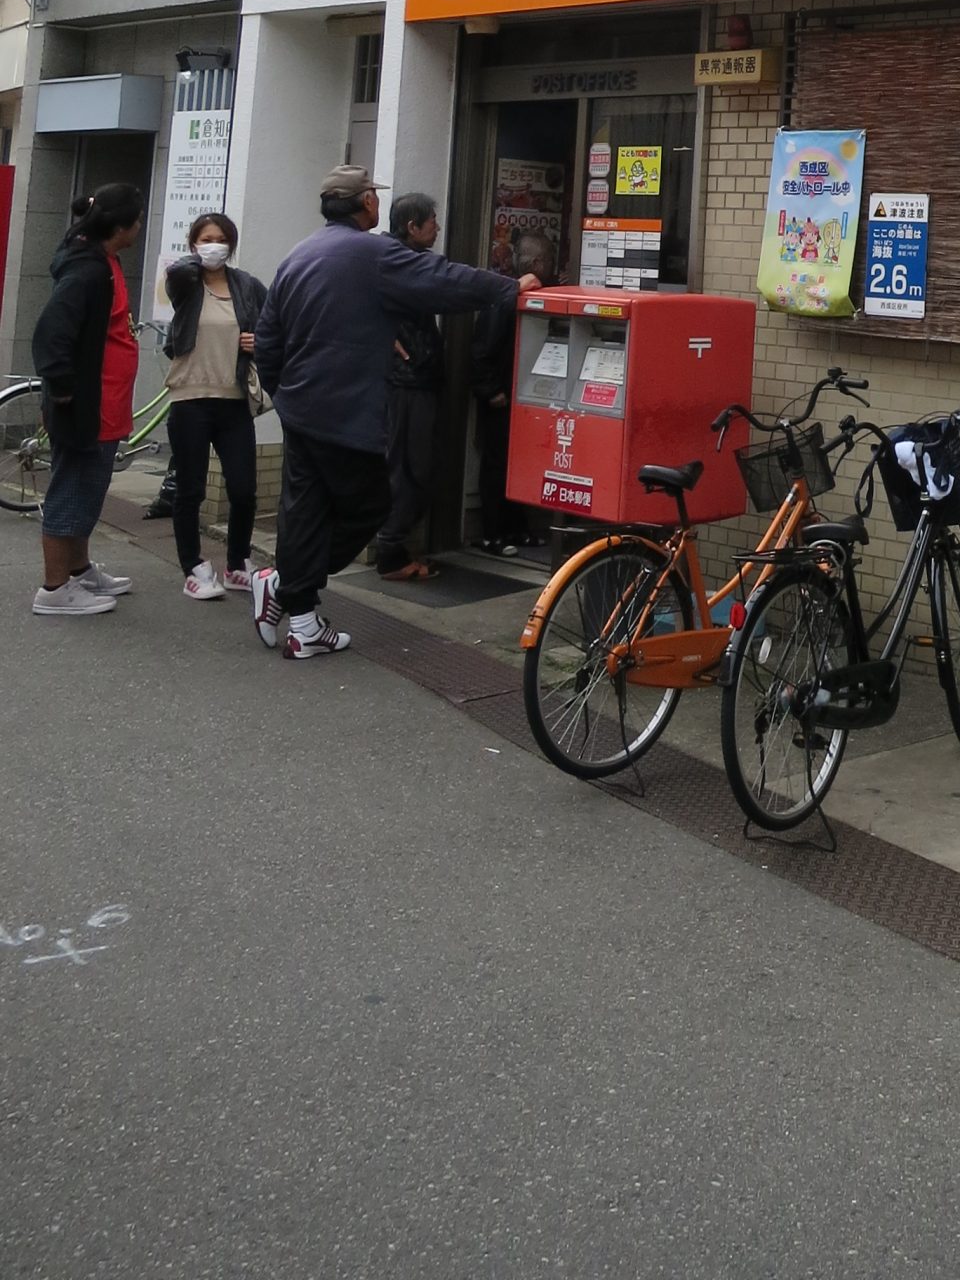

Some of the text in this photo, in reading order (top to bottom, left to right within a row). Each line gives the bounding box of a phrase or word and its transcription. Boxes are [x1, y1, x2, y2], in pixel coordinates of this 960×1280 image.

[698, 56, 756, 76] 異常通報器
[531, 70, 637, 94] POST OFFICE
[799, 161, 829, 176] 西成区
[783, 180, 850, 196] 安全パトロール中
[889, 208, 924, 219] 津波注意
[873, 229, 922, 239] ここの地面は
[556, 418, 575, 437] 郵便
[554, 451, 574, 470] POST
[560, 487, 592, 507] 日本郵便
